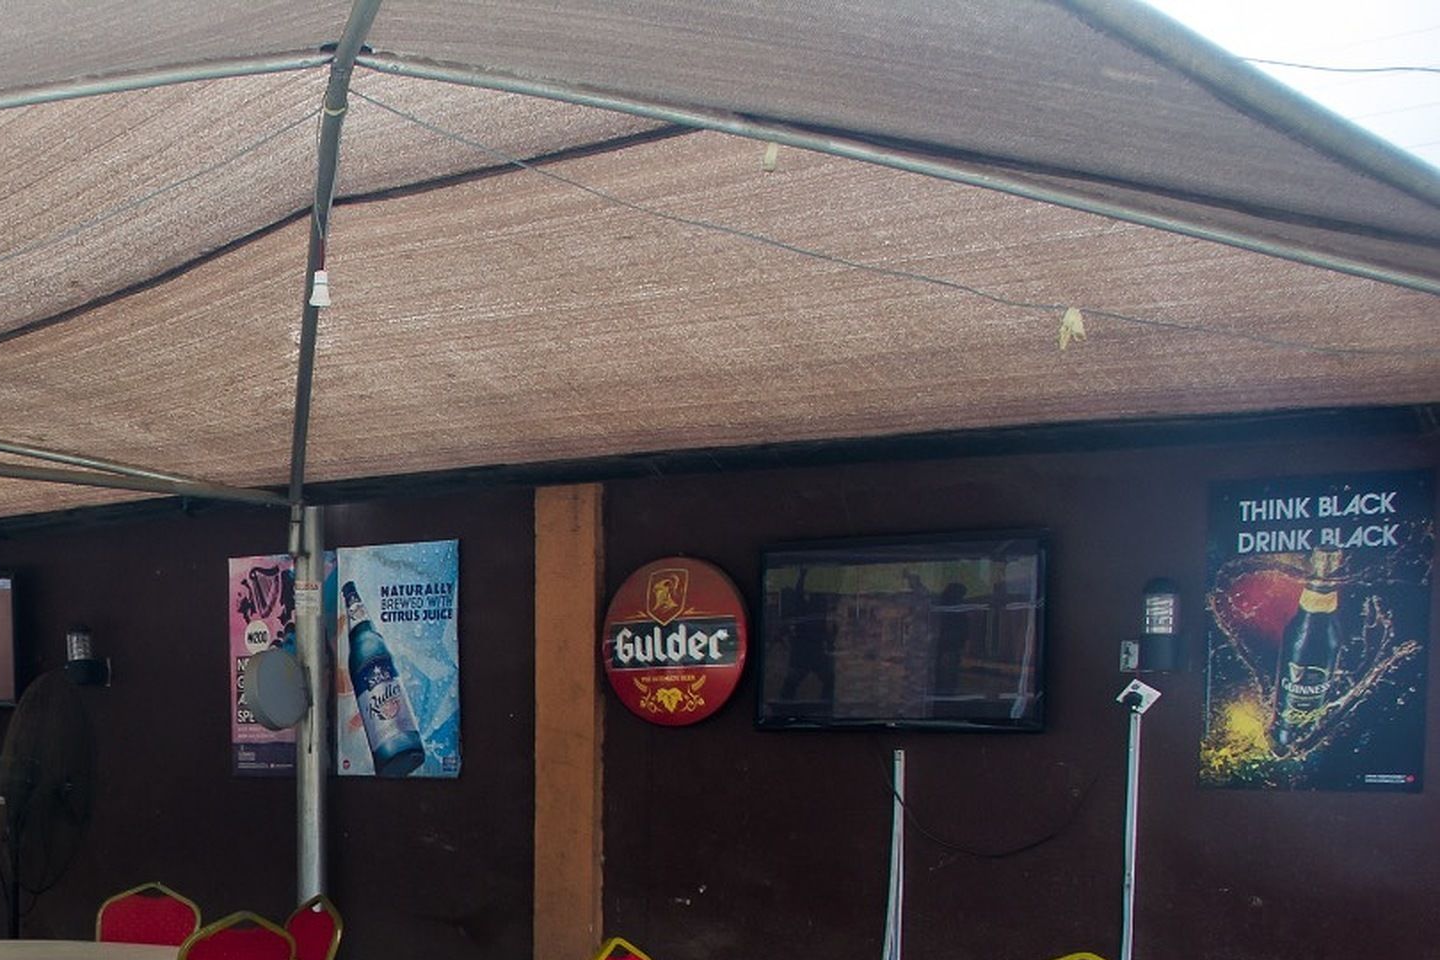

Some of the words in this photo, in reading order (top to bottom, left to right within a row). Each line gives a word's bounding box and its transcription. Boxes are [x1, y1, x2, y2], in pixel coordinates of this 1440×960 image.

[1239, 497, 1311, 522] THINK
[1318, 491, 1397, 517] BLACK
[1238, 529, 1313, 553] DRINK
[1321, 523, 1400, 548] BLACK
[381, 582, 452, 597] NATURALLY
[381, 597, 424, 610] BREWED
[426, 595, 453, 608] WITH
[381, 610, 420, 622] CITRUS
[422, 608, 453, 620] JUICE
[614, 623, 729, 664] Gulder
[1281, 677, 1331, 694] GUINNESS
